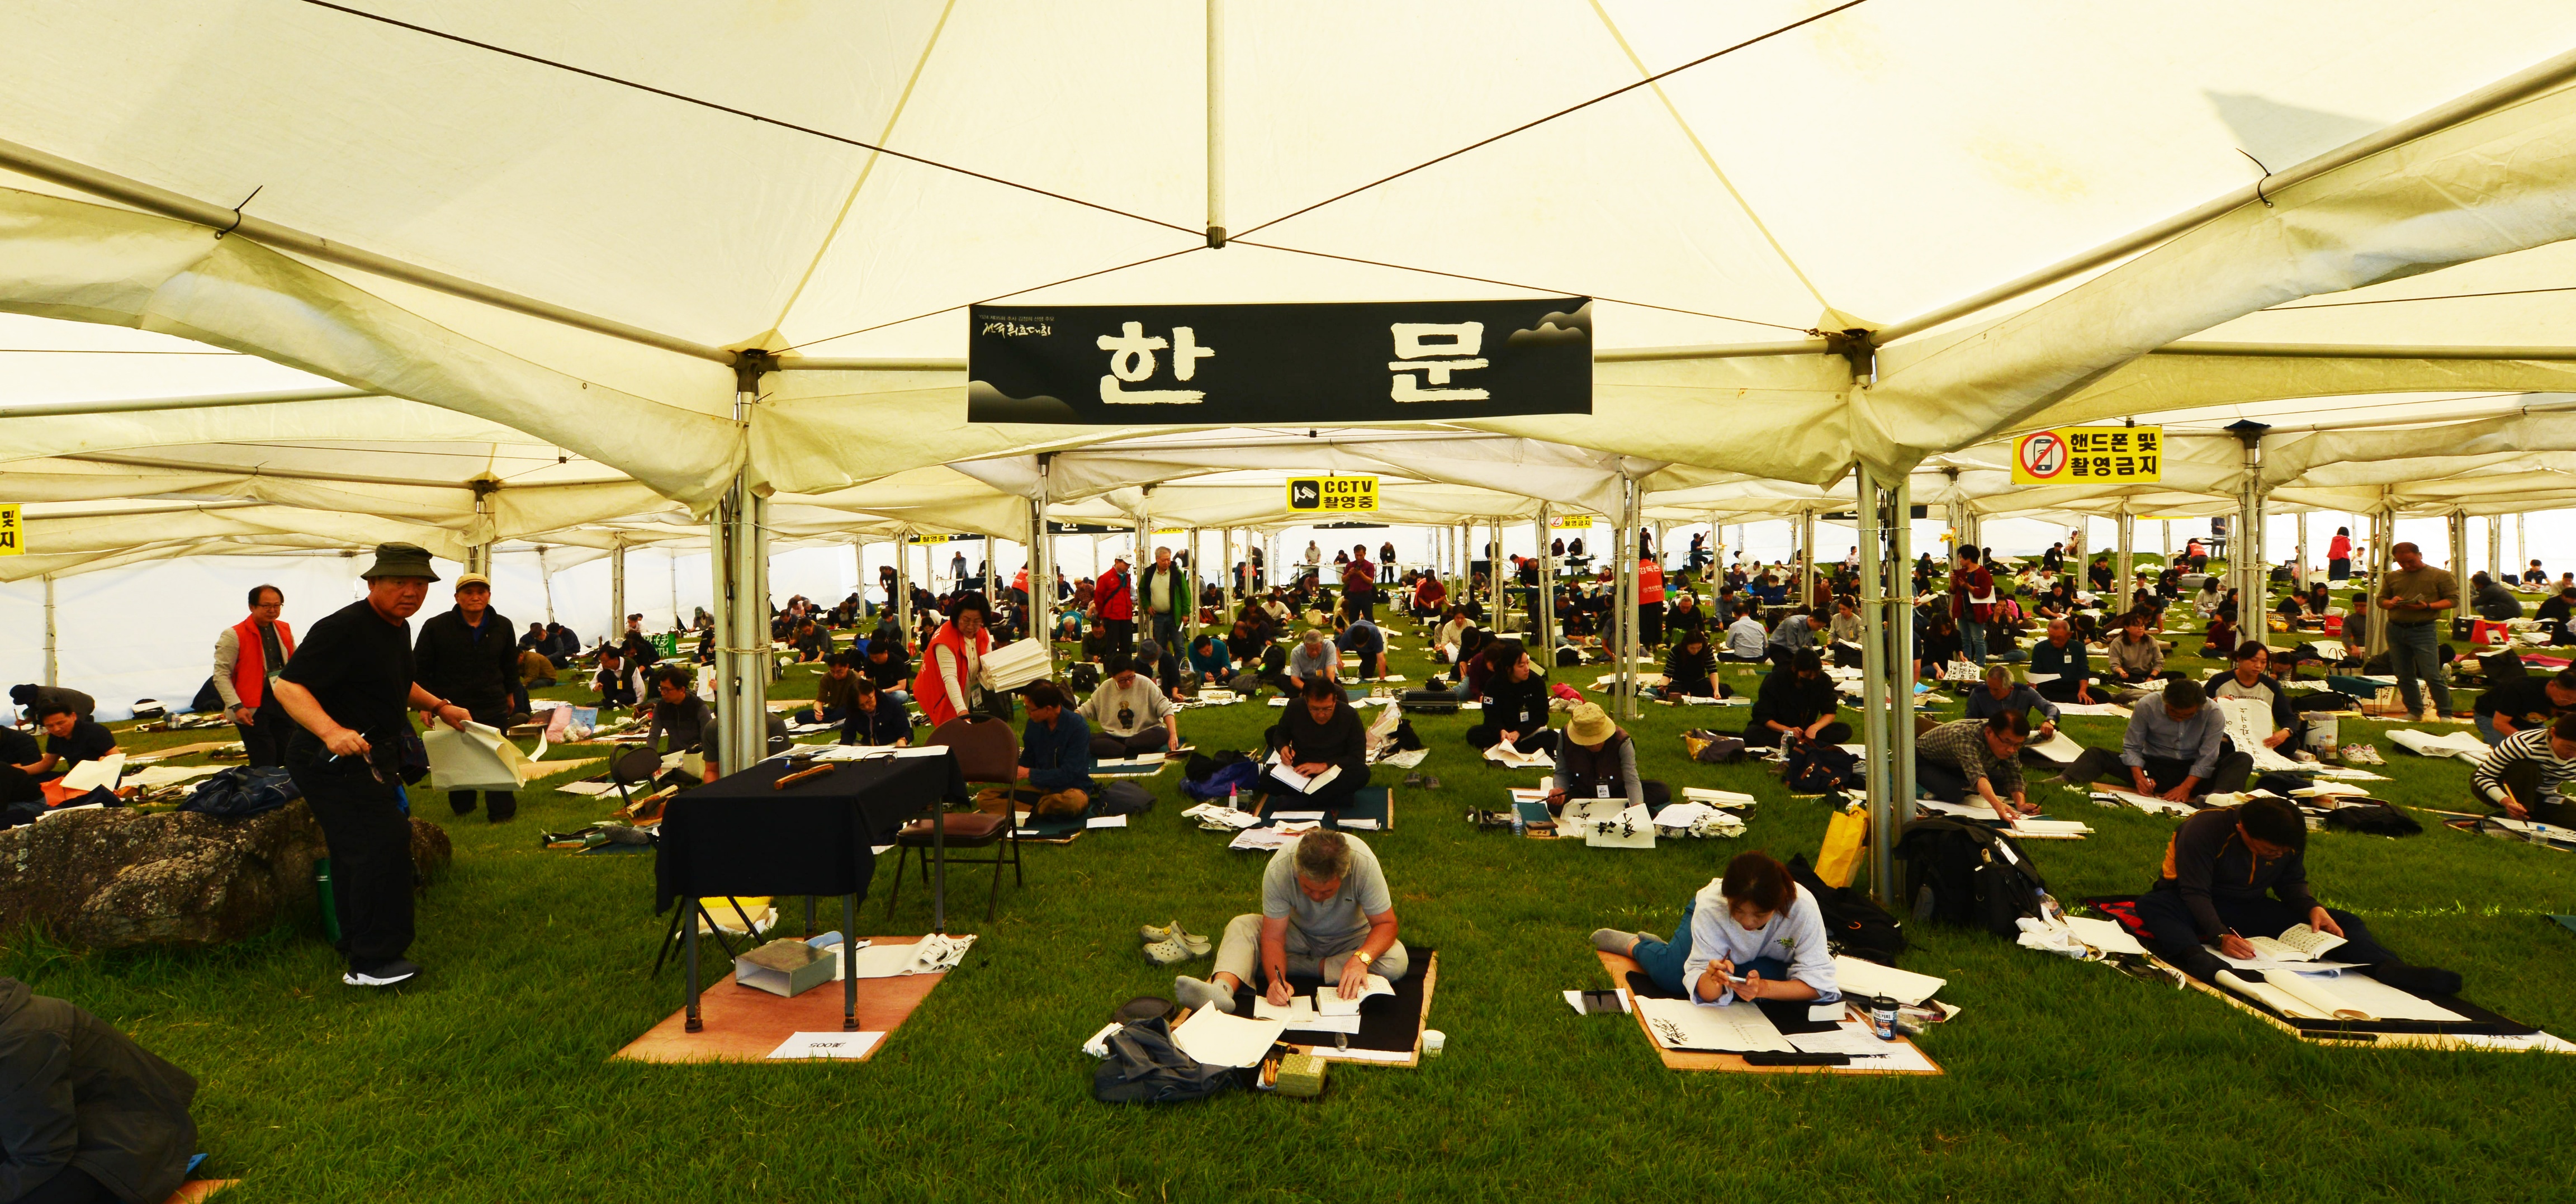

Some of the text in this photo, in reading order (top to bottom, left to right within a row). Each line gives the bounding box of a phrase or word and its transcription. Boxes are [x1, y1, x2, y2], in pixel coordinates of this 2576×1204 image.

[2070, 433, 2157, 453] 핸드폰 및
[2070, 456, 2157, 476] 촬영금지
[1324, 481, 1372, 493] CCTV
[1323, 496, 1373, 509] 촬영중
[2, 510, 15, 528] 및
[1639, 565, 1660, 575] 감독관
